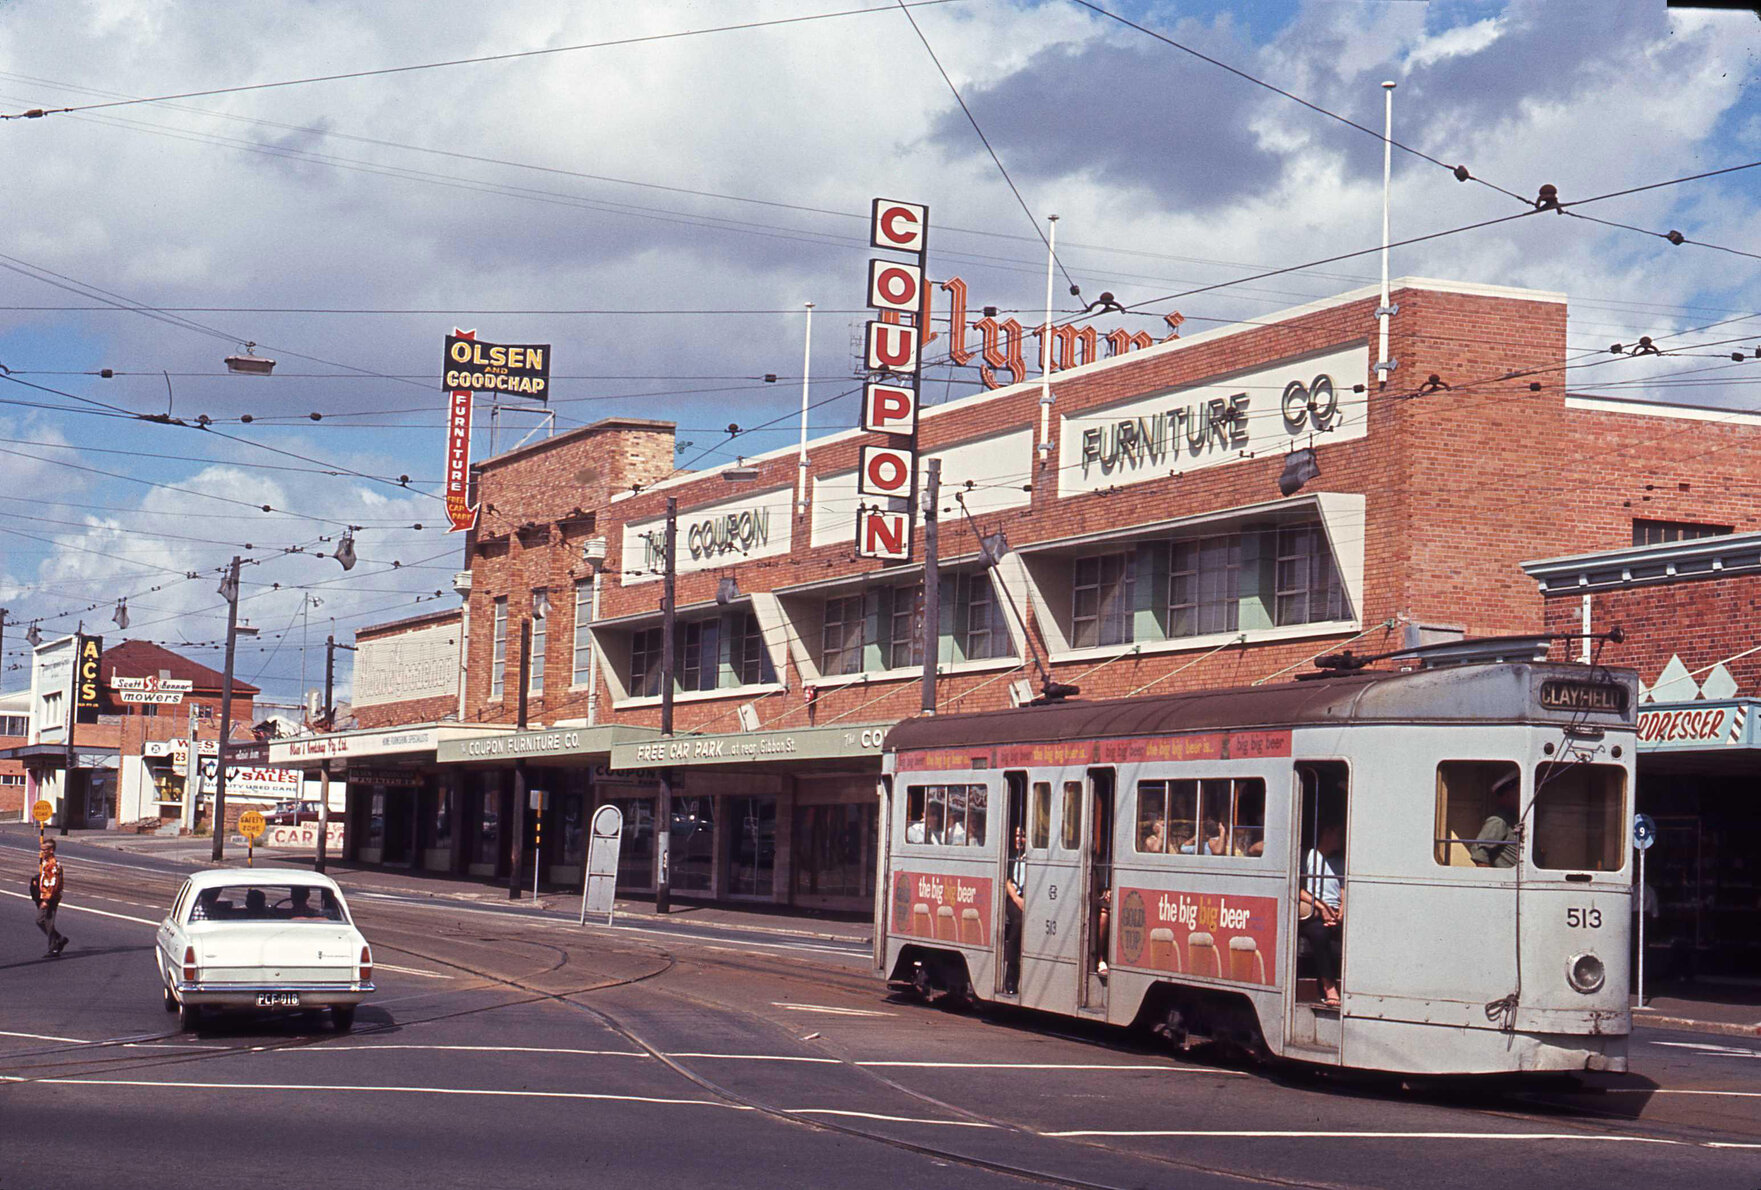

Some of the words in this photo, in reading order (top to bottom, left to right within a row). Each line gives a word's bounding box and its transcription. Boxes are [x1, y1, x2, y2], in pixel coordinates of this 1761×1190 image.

[451, 341, 544, 371] OLSEN
[446, 370, 546, 394] GOODCHAP
[484, 367, 509, 375] AND
[866, 206, 919, 555] COUPON
[1081, 391, 1251, 471] FURNITURE
[450, 395, 467, 492] FURNITURE
[688, 506, 770, 554] COUPON
[117, 679, 142, 688] Scott
[123, 692, 181, 703] mowers
[1541, 685, 1621, 708] CLAYFIELD
[1636, 709, 1725, 741] RDRESSER
[468, 740, 505, 756] COUPON
[507, 734, 561, 754] FURNITURE
[861, 729, 888, 749] CO
[1159, 740, 1170, 760] big
[1171, 740, 1183, 760] big
[1185, 739, 1201, 755] beer
[1236, 733, 1249, 755] big
[1251, 732, 1264, 754] big
[1265, 733, 1285, 750] beer
[175, 752, 186, 761] 23
[637, 744, 666, 762] FREE
[670, 742, 690, 760] CAR
[760, 739, 785, 754] Gibbon
[242, 772, 298, 783] SALES
[240, 816, 265, 824] SAFETY
[274, 829, 313, 843] CAR
[1639, 826, 1646, 837] 9
[918, 876, 931, 898] the
[931, 877, 944, 905] big
[944, 878, 957, 906] big
[957, 879, 976, 904] beer
[1158, 893, 1178, 923] the
[1179, 895, 1198, 931] big
[1199, 896, 1219, 932] big
[1219, 898, 1250, 930] beer
[1566, 907, 1603, 929] 513
